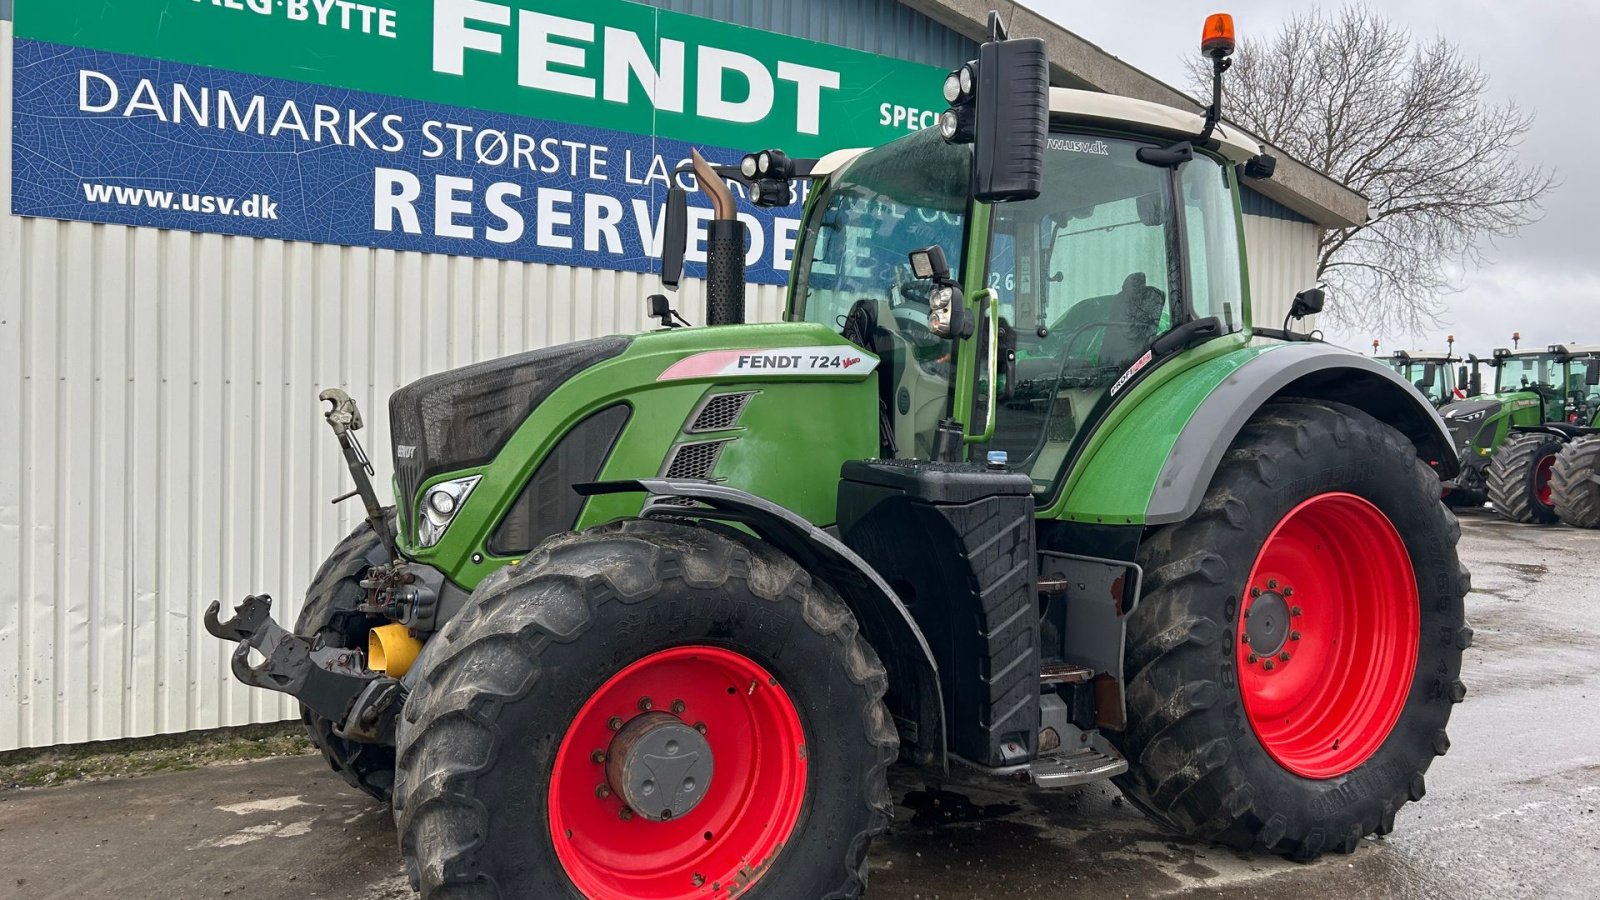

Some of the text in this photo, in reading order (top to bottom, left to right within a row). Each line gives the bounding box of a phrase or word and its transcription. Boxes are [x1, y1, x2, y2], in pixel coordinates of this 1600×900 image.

[432, 0, 841, 136] FENDT
[79, 69, 405, 153] DANMARKS
[422, 120, 609, 181] STØRSTE
[83, 182, 279, 221] www.usv.dk
[737, 355, 802, 369] FENDT
[809, 355, 841, 369] 724
